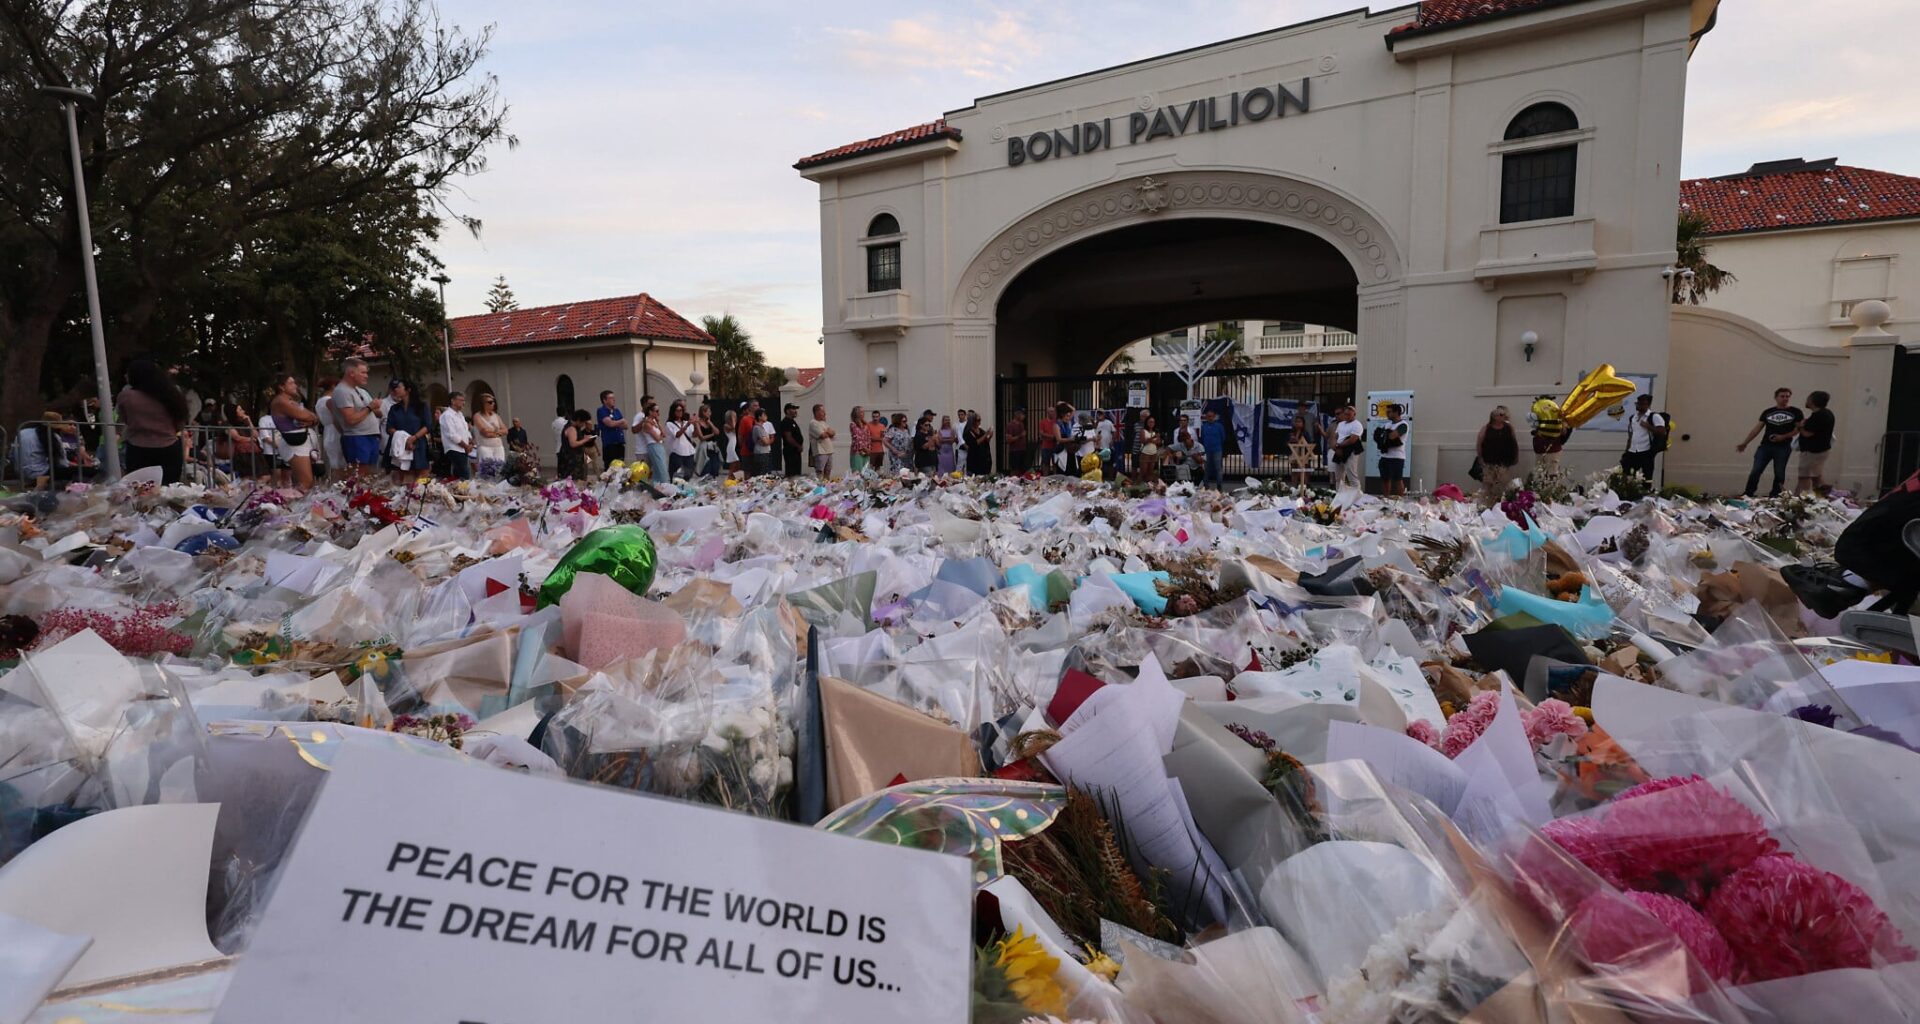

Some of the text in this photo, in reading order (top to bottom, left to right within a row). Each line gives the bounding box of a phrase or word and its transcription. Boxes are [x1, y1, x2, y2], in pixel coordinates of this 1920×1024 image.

[1007, 76, 1311, 168] BONDI PAVILION
[341, 888, 902, 993] THE DREAM FOR ALL OF US...
[386, 842, 887, 944] PEACE FOR THE WORLD IS
